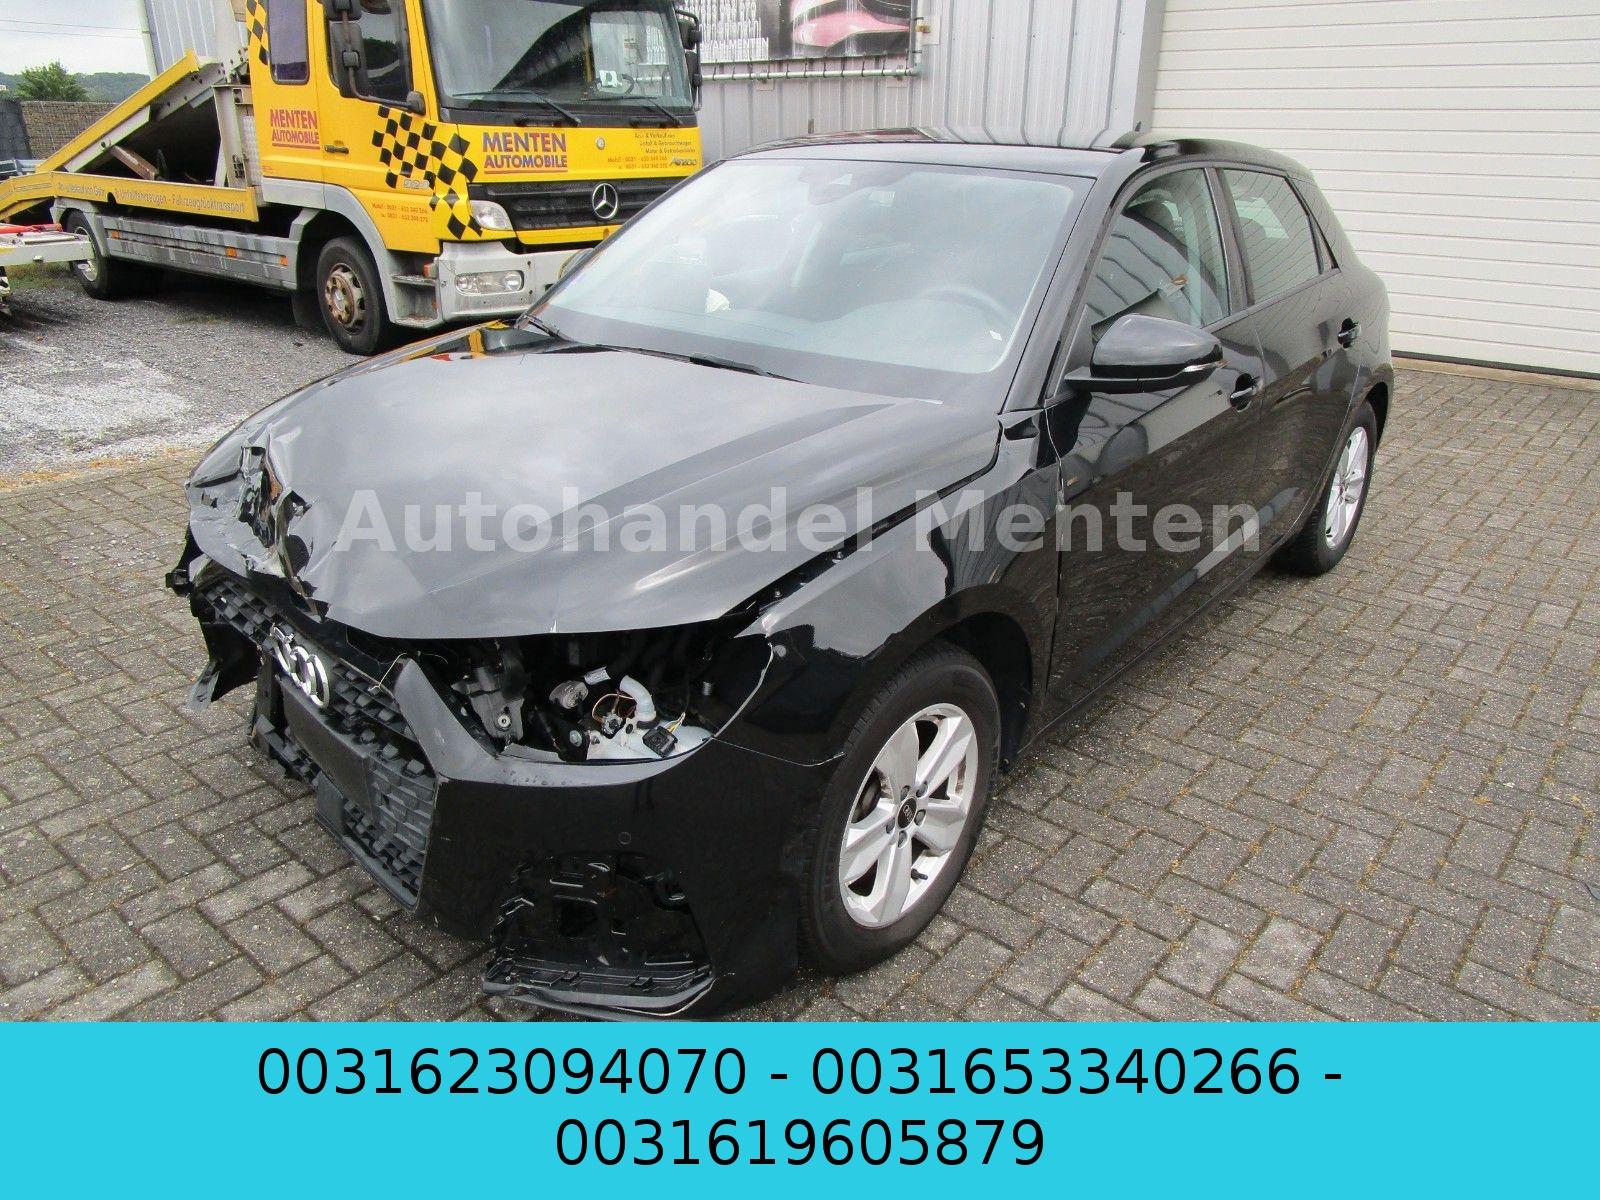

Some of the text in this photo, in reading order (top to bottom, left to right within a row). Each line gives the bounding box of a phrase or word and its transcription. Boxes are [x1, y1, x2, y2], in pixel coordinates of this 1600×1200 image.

[270, 109, 318, 129] MENTEN
[272, 130, 320, 144] AUTOMOBILE
[482, 131, 567, 152] MENTEN
[484, 154, 568, 168] AUTOMOBILE
